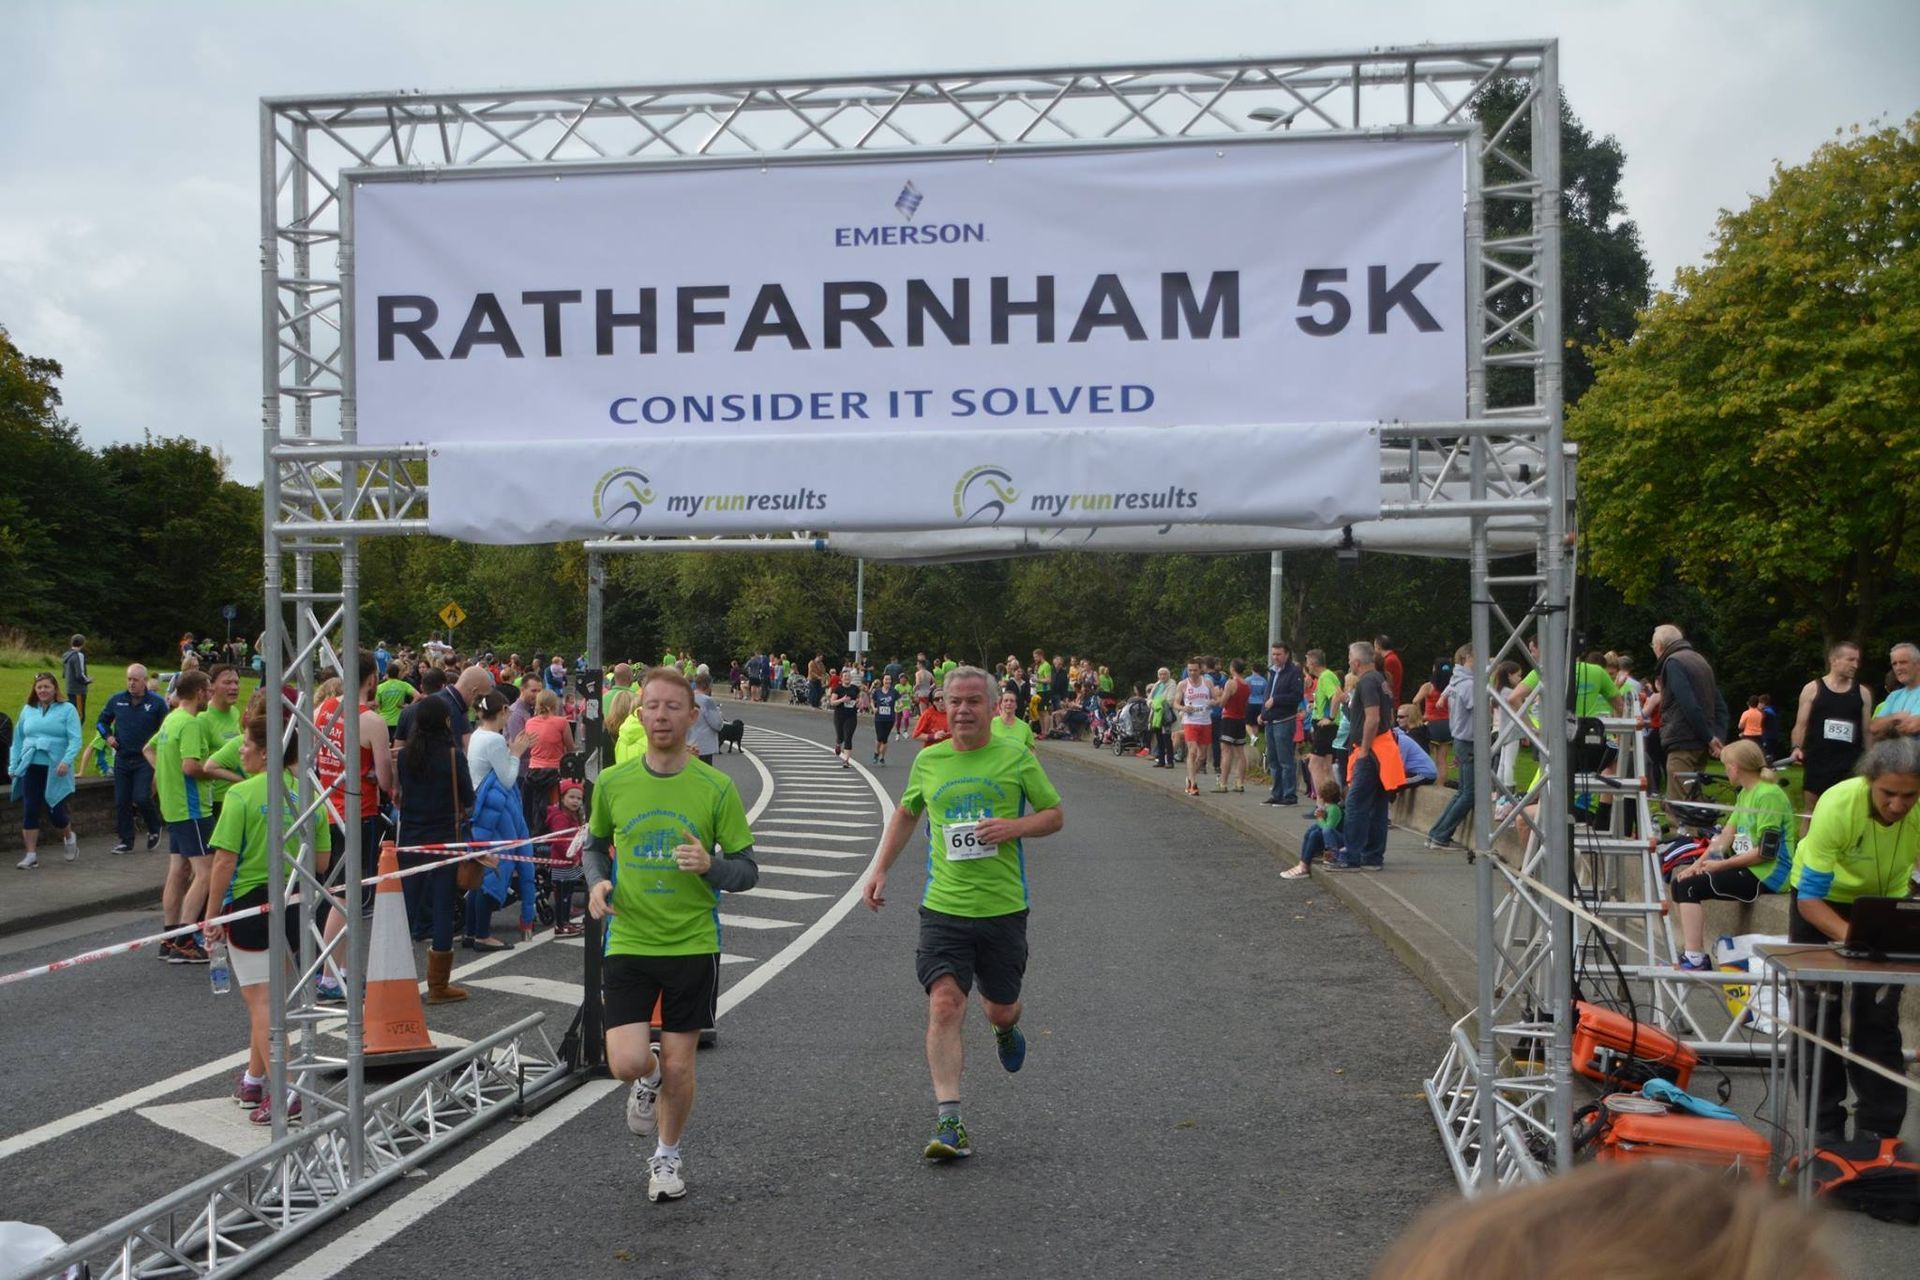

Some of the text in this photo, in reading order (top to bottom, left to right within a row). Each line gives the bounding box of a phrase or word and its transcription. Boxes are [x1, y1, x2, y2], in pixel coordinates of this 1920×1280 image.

[836, 222, 984, 247] EMERSON
[377, 262, 1444, 361] RATHFARNHAM 5K
[609, 385, 1155, 425] CONSIDER IT SOLVED
[667, 488, 828, 518] myrunresults
[1030, 486, 1198, 517] myrunresults
[1827, 725, 1850, 736] 852
